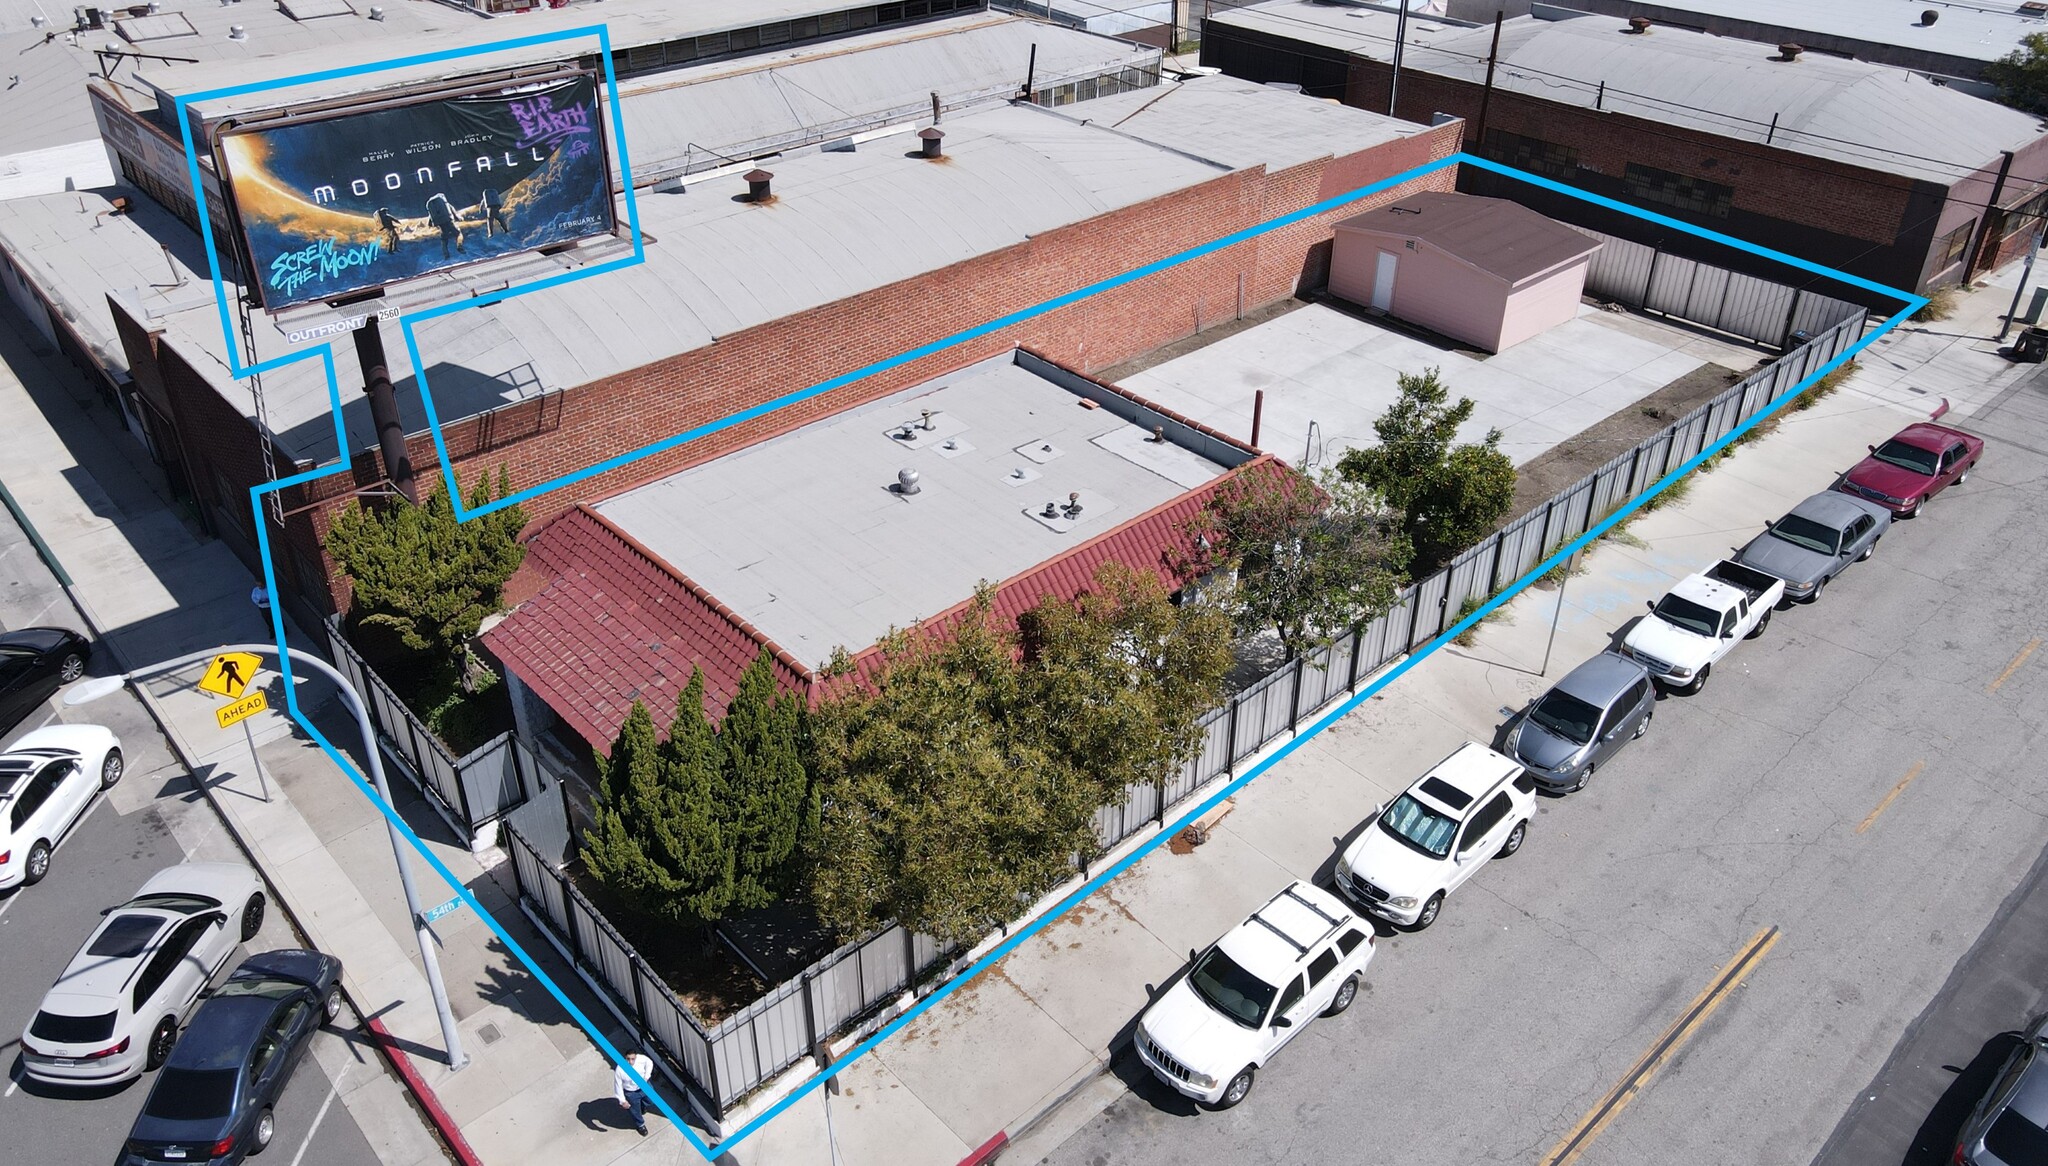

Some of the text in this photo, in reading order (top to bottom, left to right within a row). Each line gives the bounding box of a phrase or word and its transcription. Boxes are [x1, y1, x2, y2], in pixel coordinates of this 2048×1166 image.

[518, 101, 588, 140] EARTH
[405, 143, 441, 155] WILSON
[450, 134, 494, 147] BRADLEY
[362, 151, 395, 163] BERRY
[313, 147, 545, 204] MOONFALL
[558, 215, 595, 229] FEBRUARY
[270, 236, 337, 288] SCREW
[277, 236, 382, 297] THE MOON!
[379, 308, 400, 320] 2560
[289, 316, 364, 342] OUTFRONT
[223, 698, 262, 721] AHEAD
[432, 902, 455, 919] 54th
